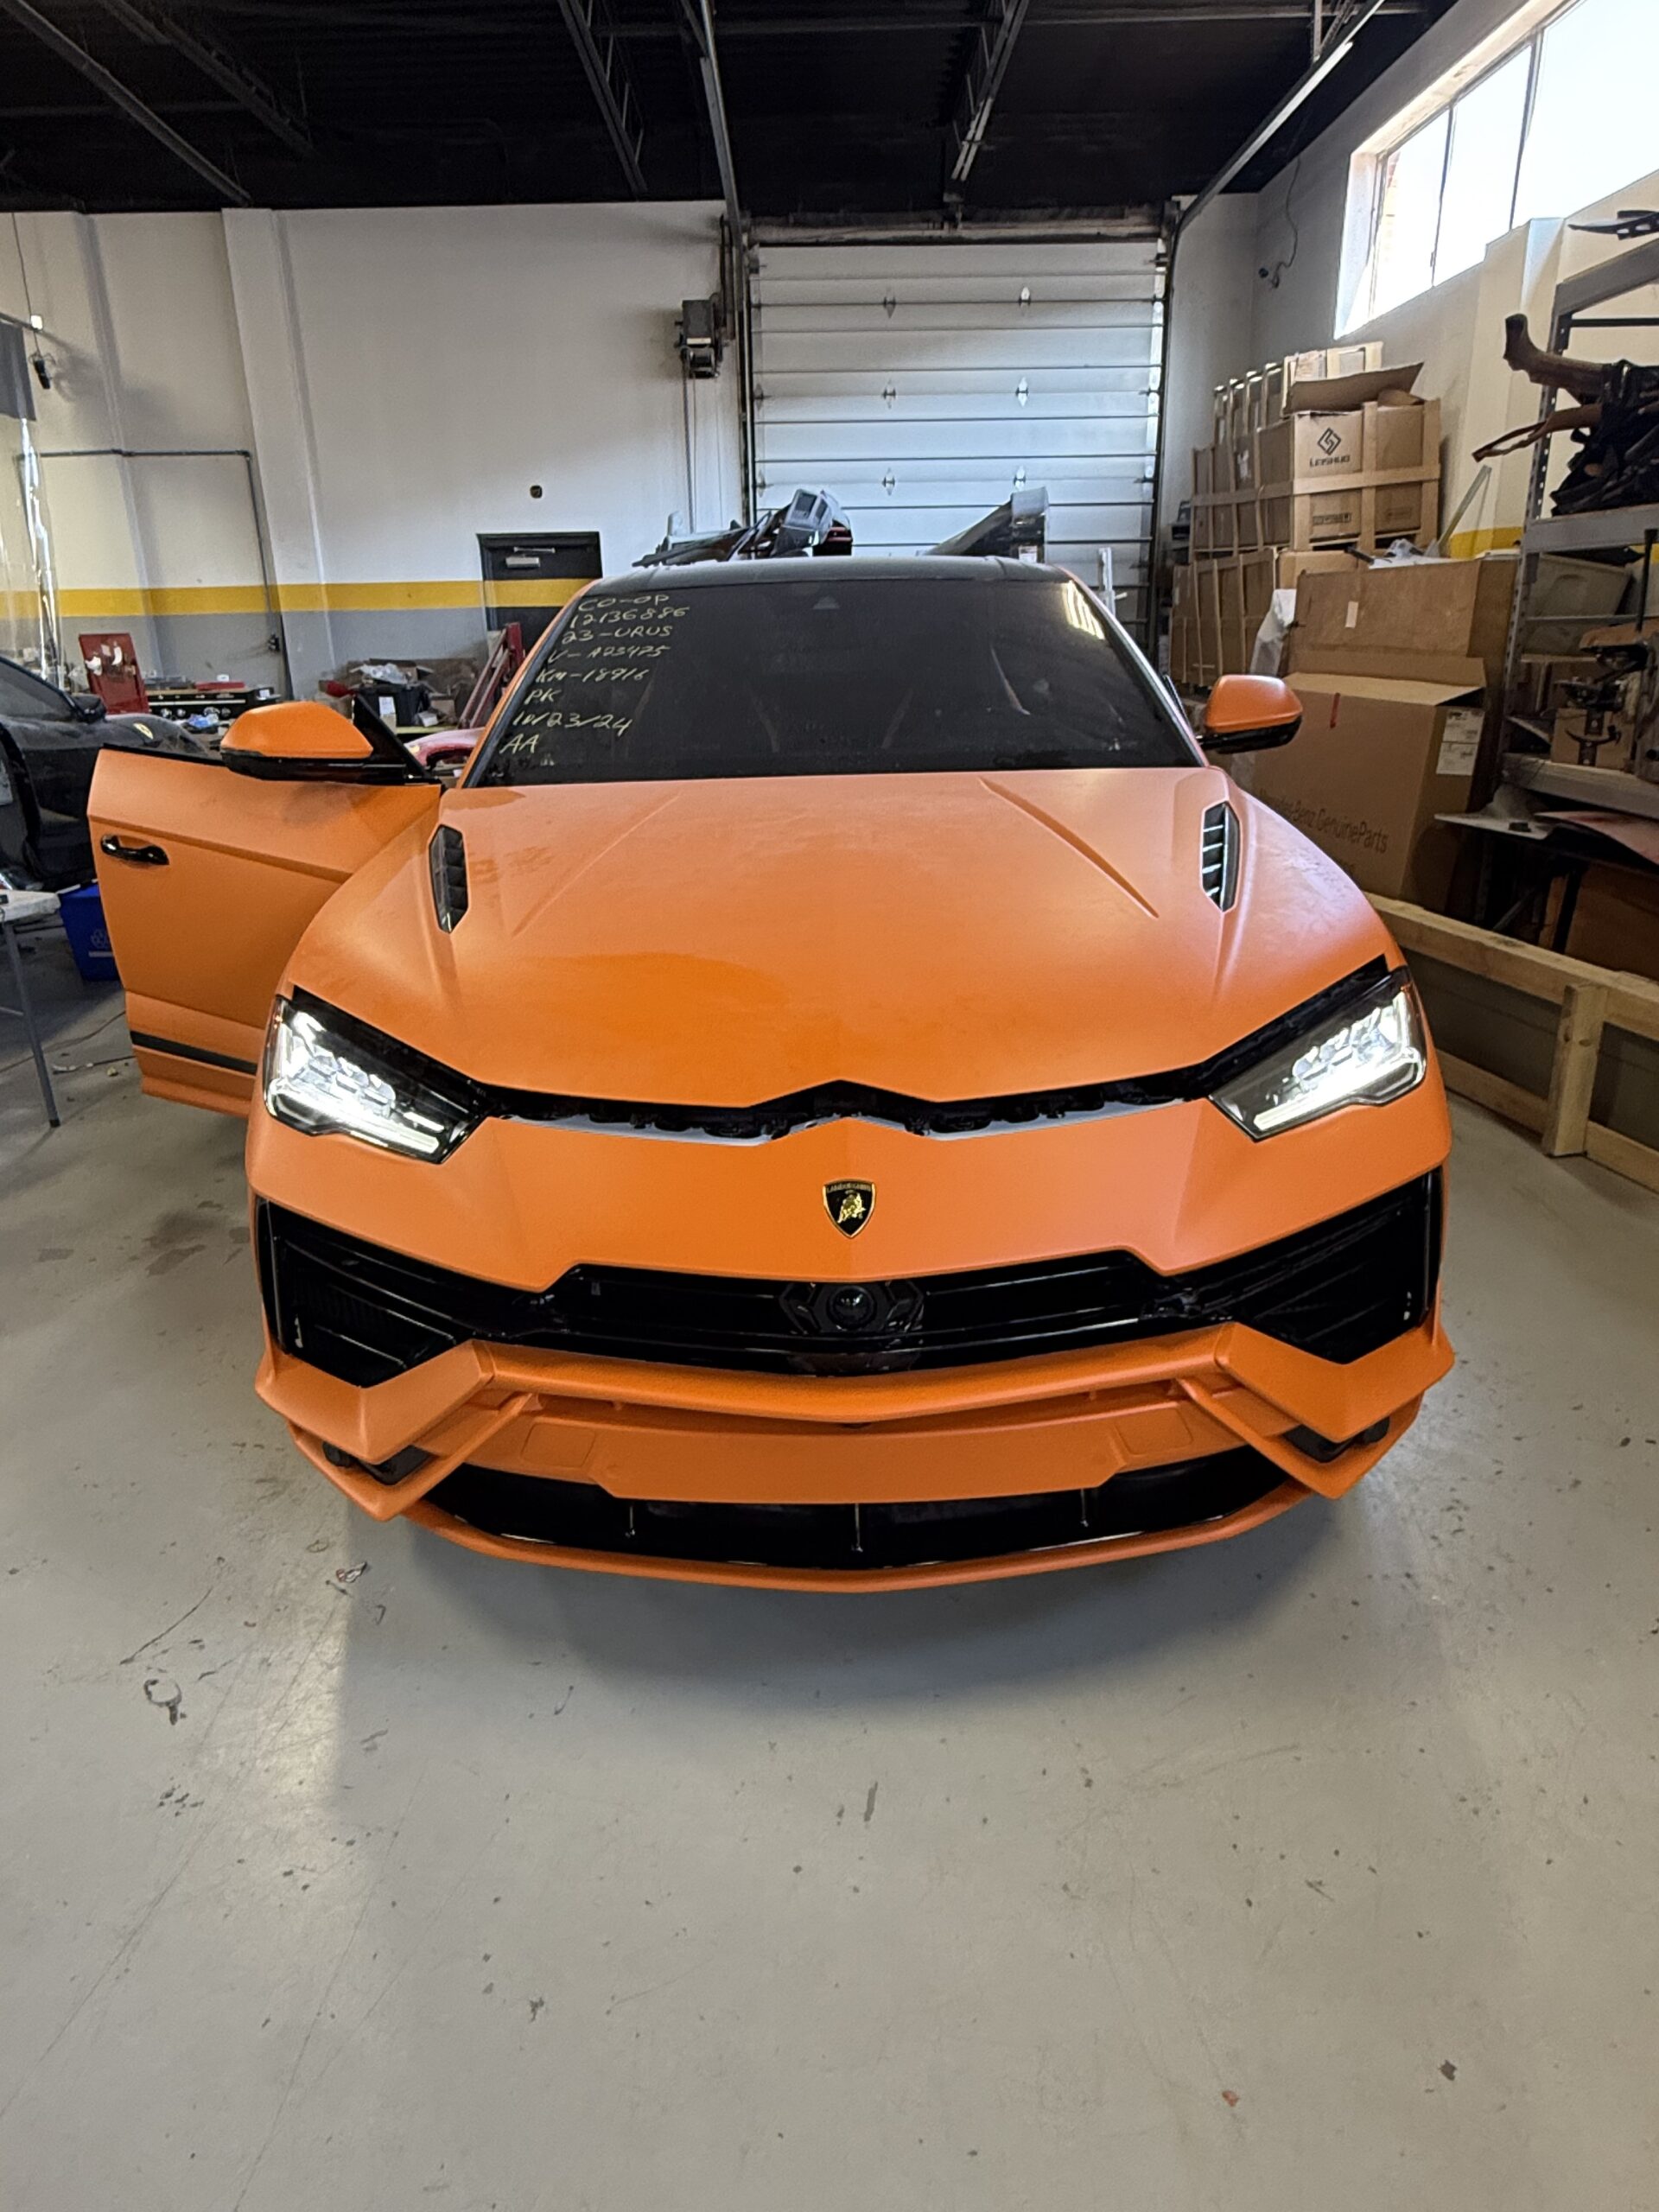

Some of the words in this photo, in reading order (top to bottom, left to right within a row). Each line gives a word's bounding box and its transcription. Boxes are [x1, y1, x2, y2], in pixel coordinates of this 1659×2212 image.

[578, 594, 669, 611] CO-OP
[570, 607, 690, 629] 12136886
[524, 688, 562, 704] PK
[499, 734, 540, 754] AA
